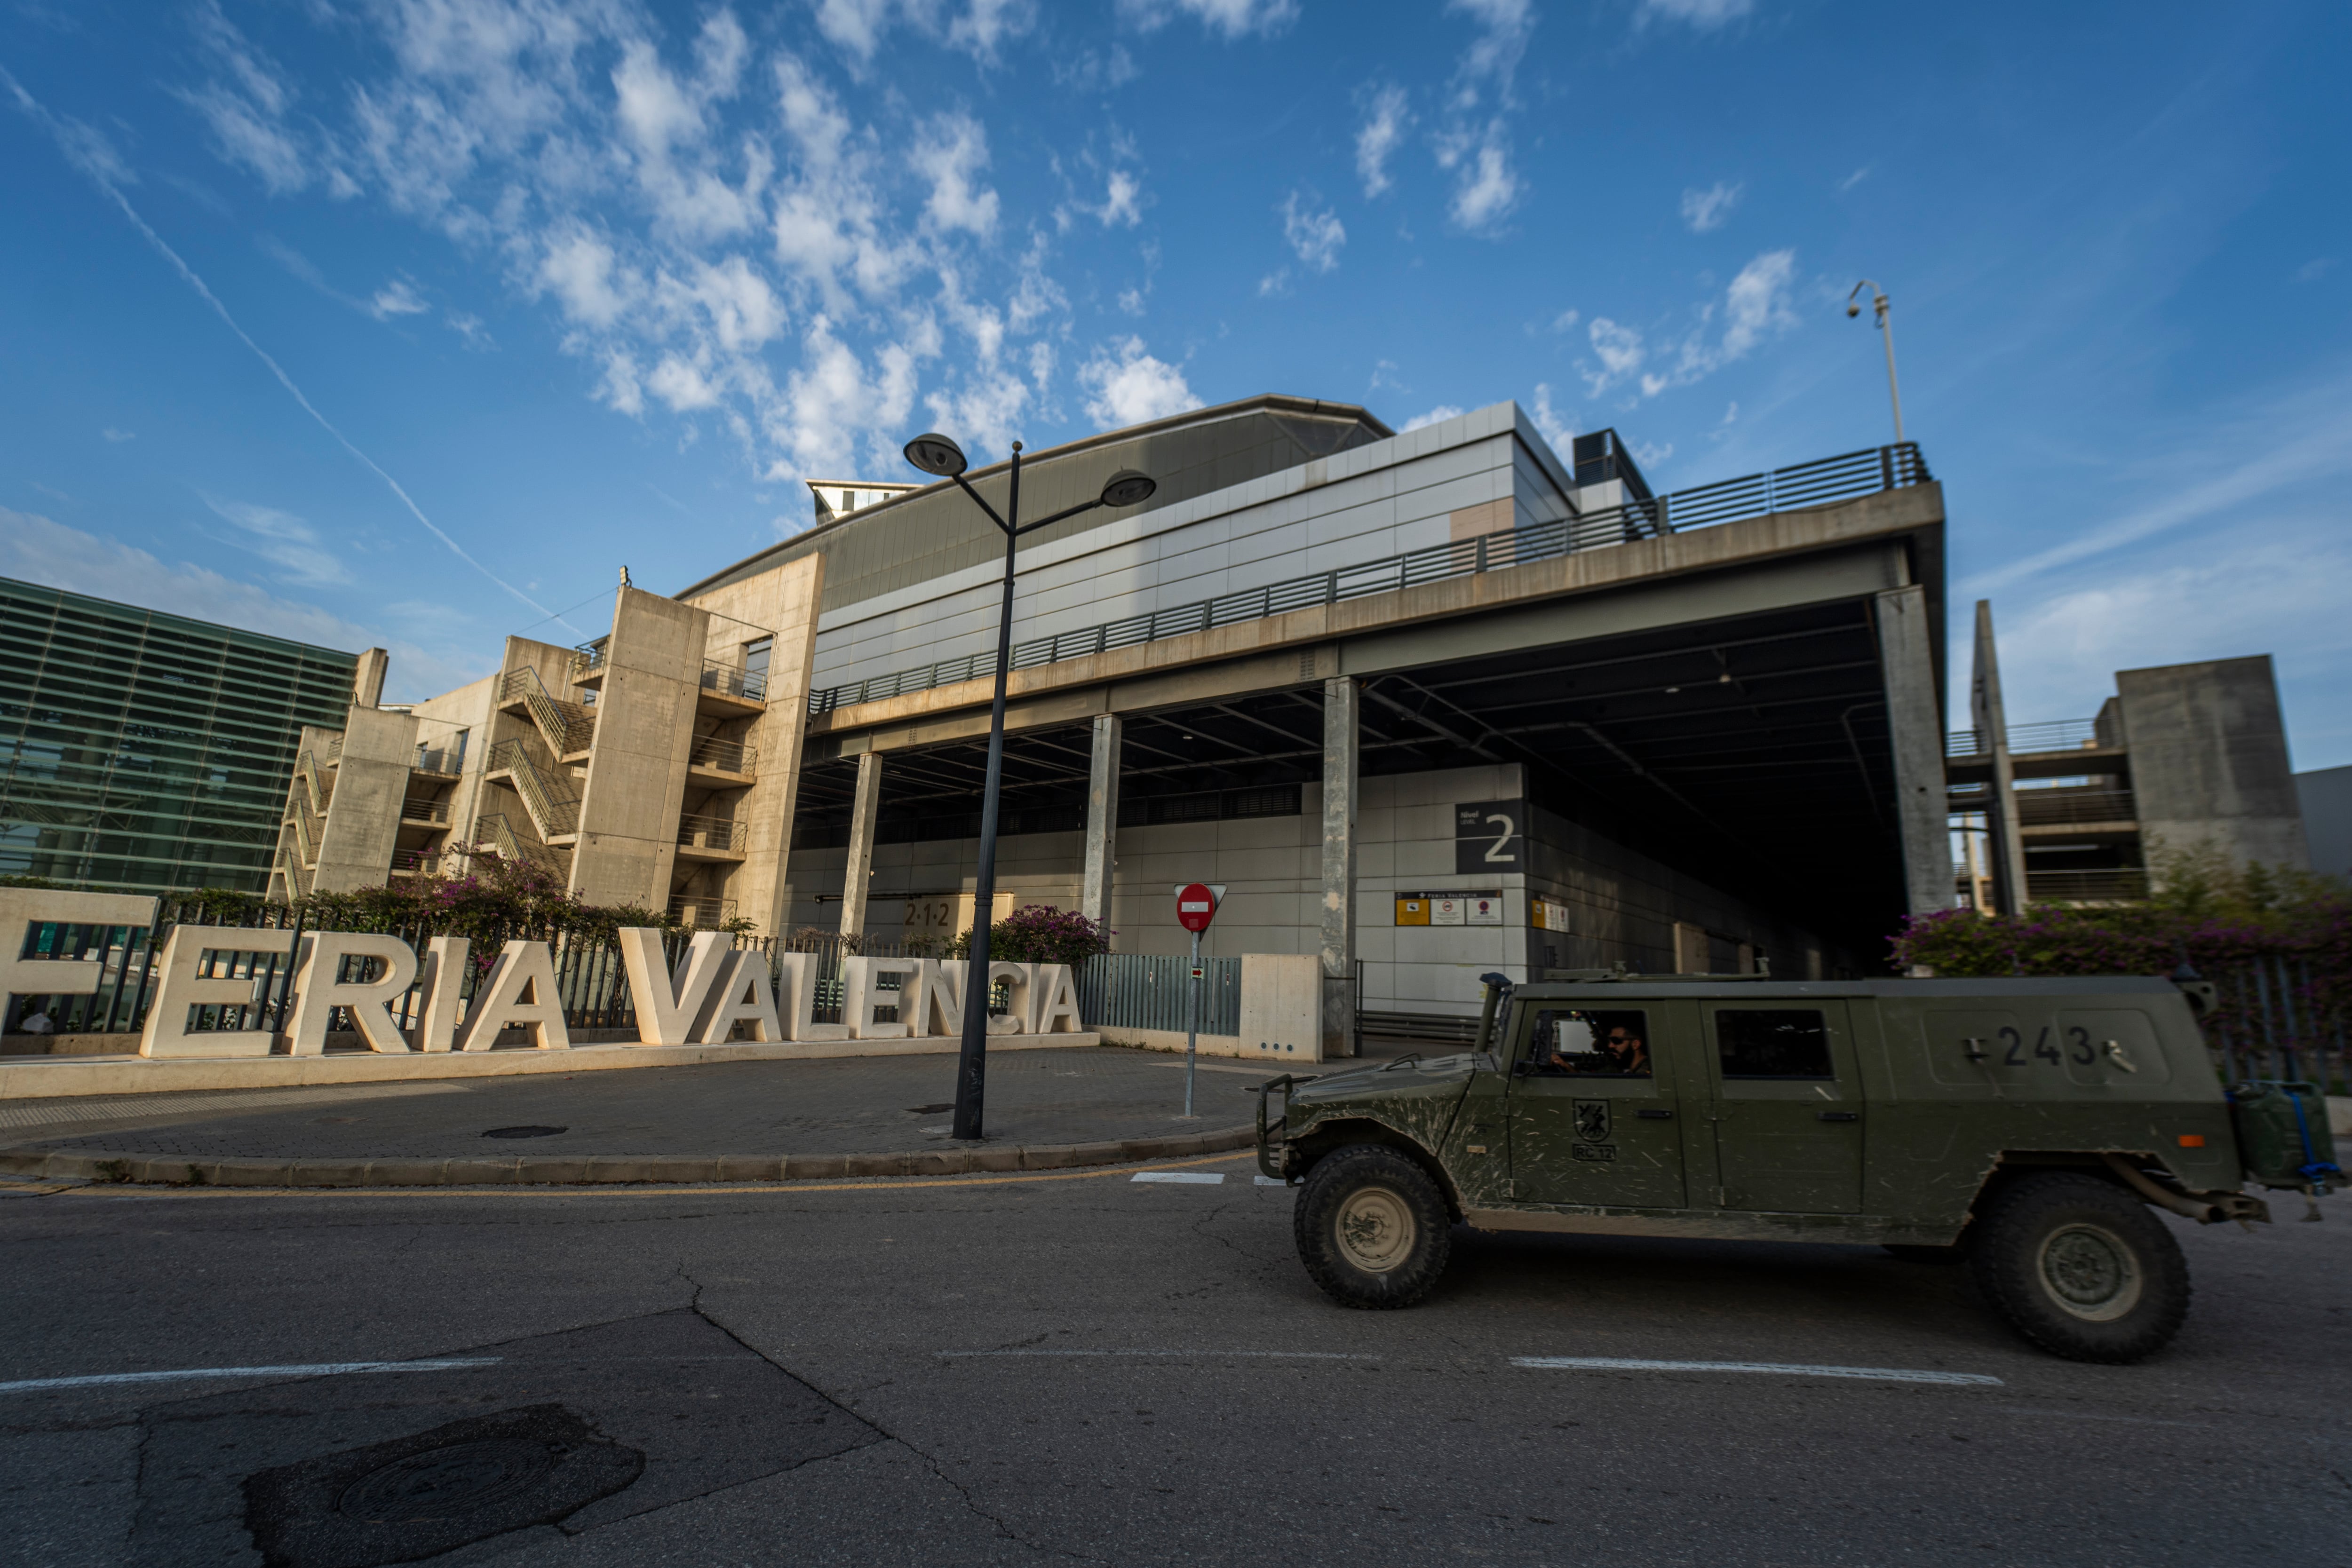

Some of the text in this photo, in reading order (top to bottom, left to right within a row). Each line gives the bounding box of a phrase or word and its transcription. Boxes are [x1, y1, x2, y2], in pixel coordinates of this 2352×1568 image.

[1460, 810, 1479, 818] Nivel
[1485, 814, 1515, 862] 2
[0, 887, 1082, 1057] FERIA VALENCIA
[1998, 1027, 2095, 1065] 243
[1576, 1148, 1612, 1158] RC 12
